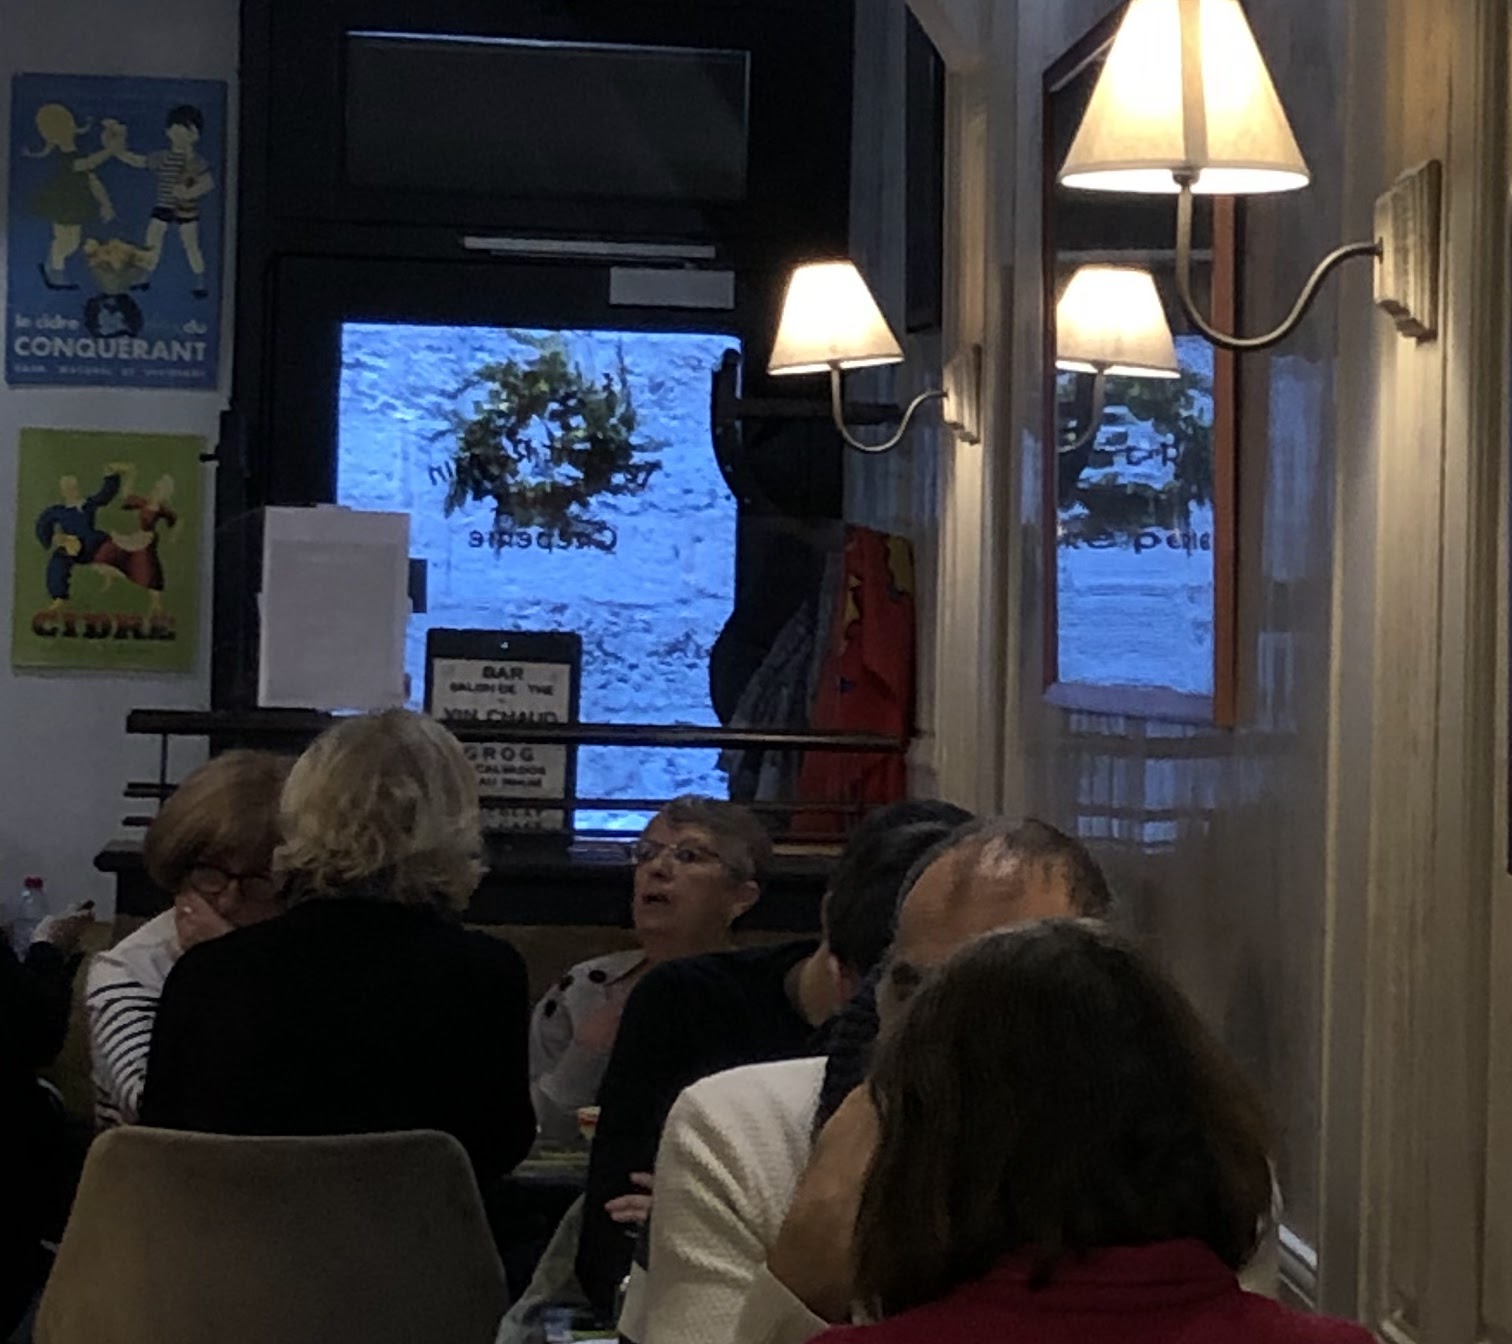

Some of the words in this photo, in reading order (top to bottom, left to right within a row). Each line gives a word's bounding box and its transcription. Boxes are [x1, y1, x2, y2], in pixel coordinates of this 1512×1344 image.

[32, 611, 176, 641] CIDRE
[482, 665, 525, 680] BAR
[464, 745, 534, 762] GROG
